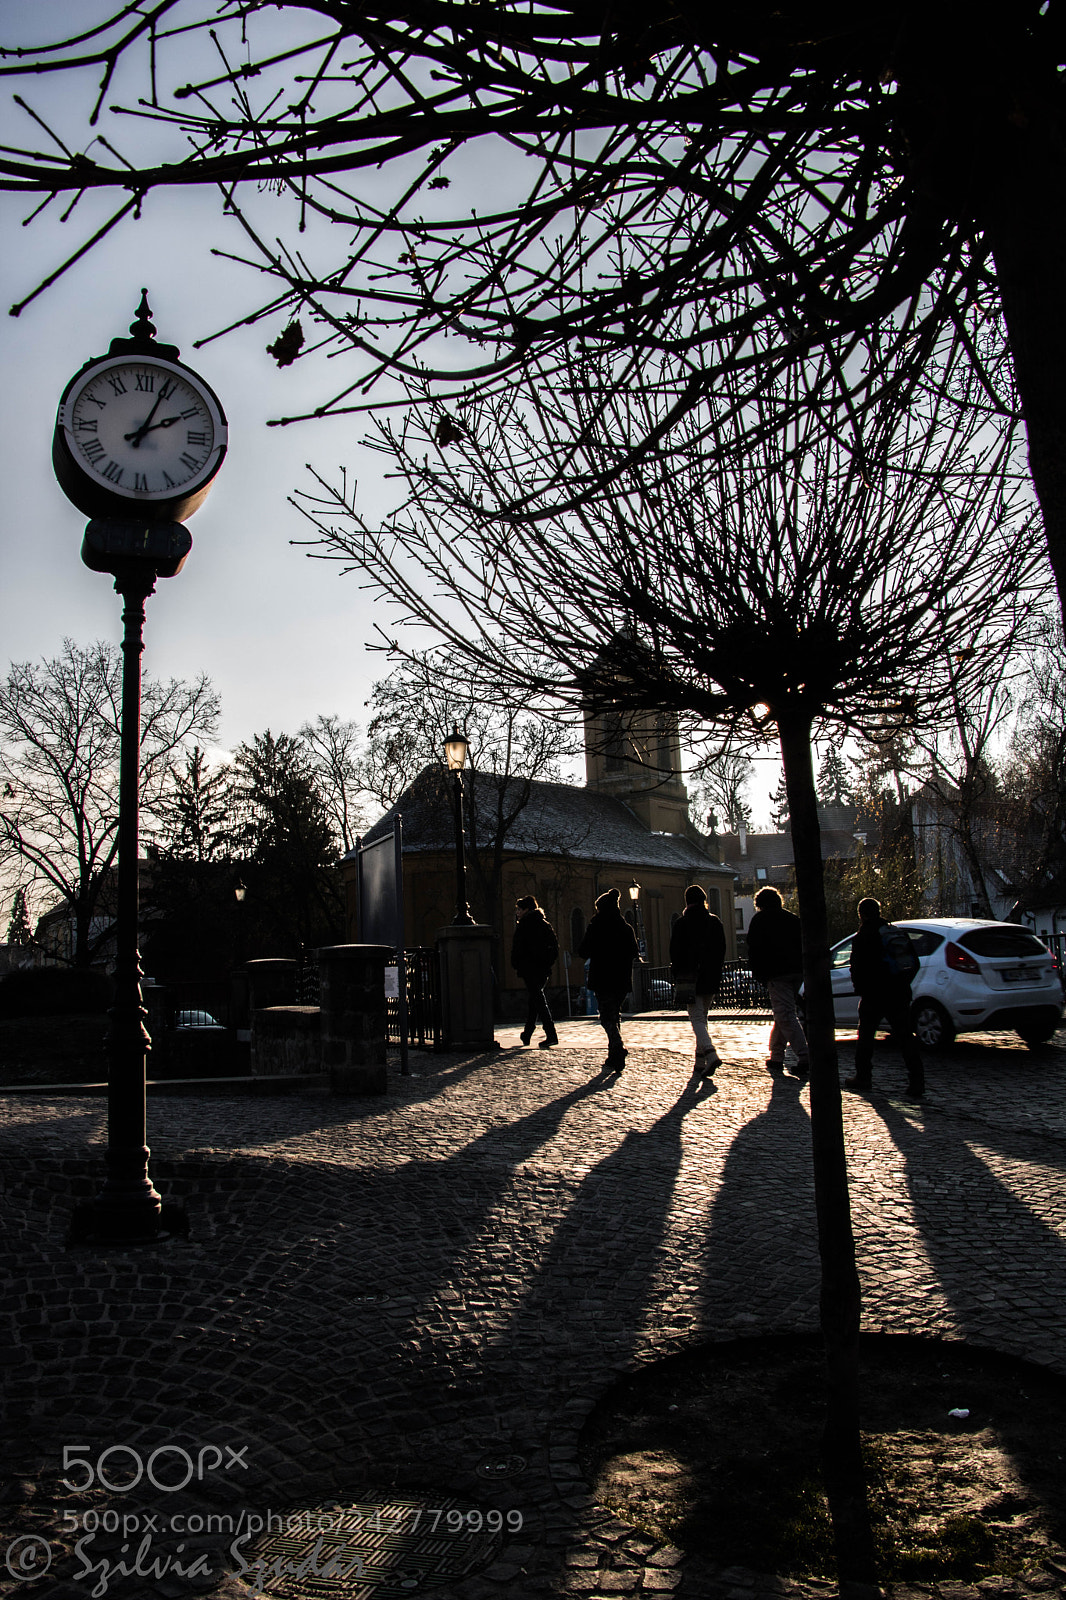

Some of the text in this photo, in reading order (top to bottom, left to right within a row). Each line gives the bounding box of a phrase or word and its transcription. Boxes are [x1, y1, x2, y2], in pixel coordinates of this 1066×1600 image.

[108, 376, 128, 397] XI
[134, 374, 154, 393] XII
[87, 393, 107, 410] X
[180, 406, 200, 420] II
[78, 418, 98, 433] IX
[187, 430, 206, 446] III
[82, 438, 108, 465] VIII
[179, 452, 202, 471] IV
[102, 460, 125, 484] VII
[134, 472, 149, 491] VI
[162, 470, 175, 488] V
